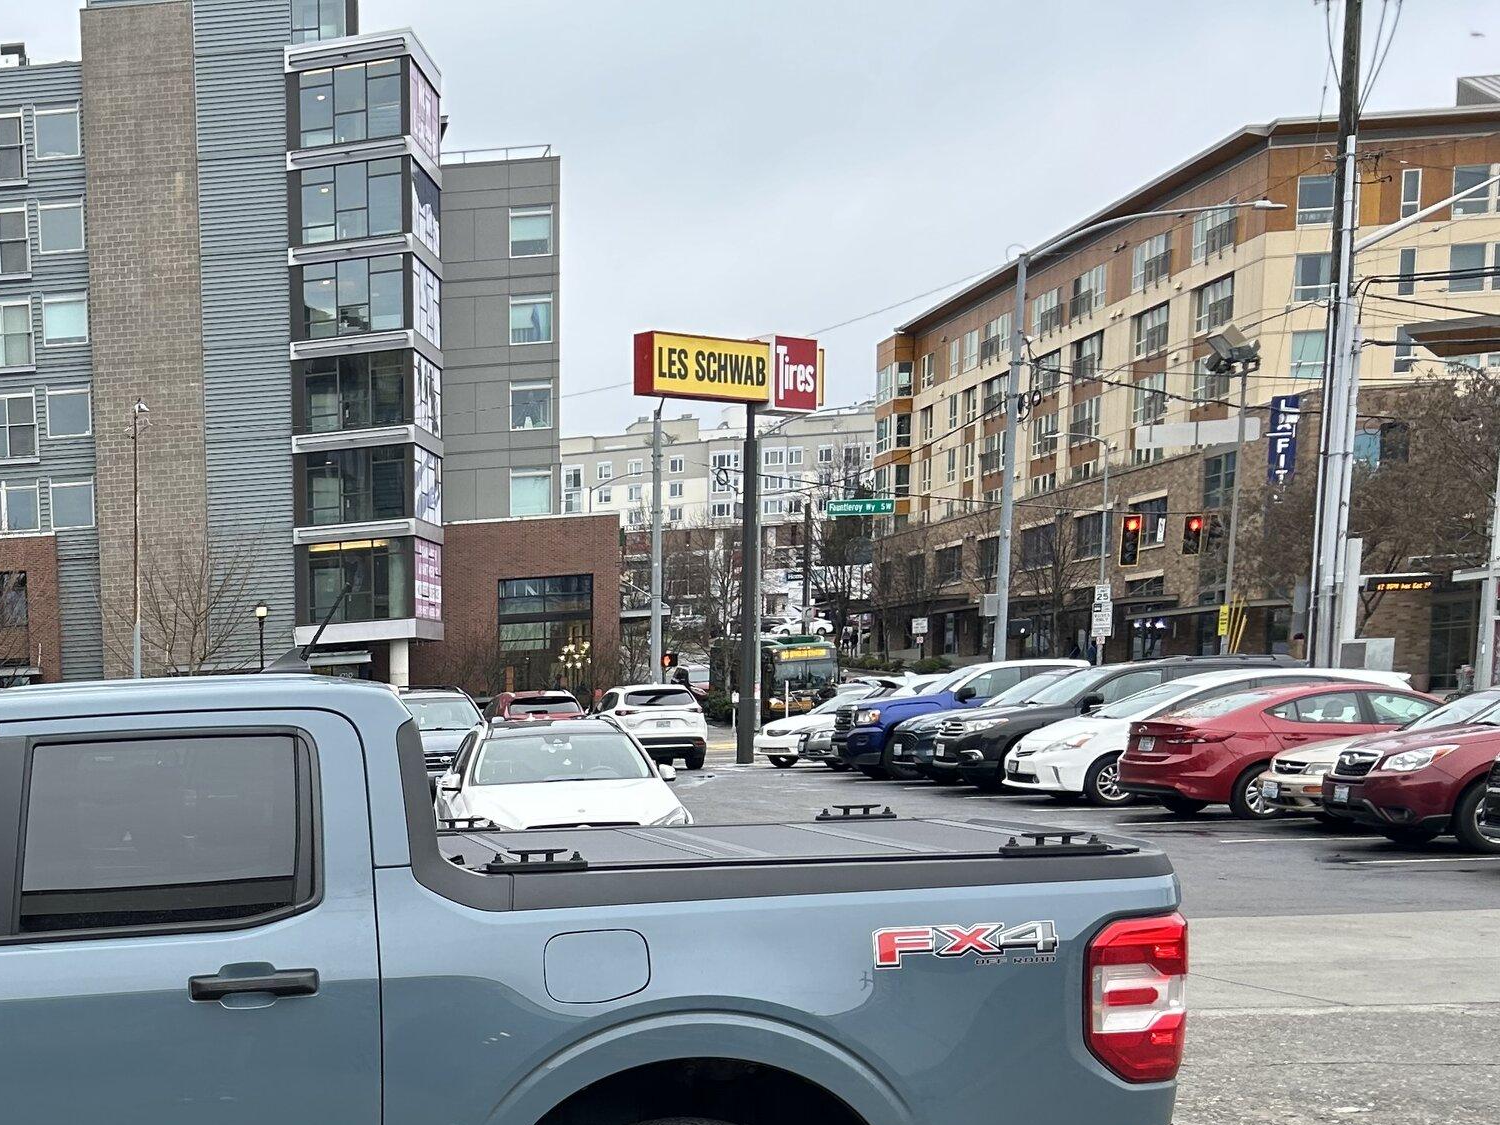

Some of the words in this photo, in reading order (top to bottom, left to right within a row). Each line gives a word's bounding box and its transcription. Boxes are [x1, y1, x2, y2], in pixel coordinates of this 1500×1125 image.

[657, 347, 689, 380] LES
[695, 350, 766, 387] SCHWAB
[776, 345, 815, 400] Tires
[828, 503, 863, 512] Fauntleroy
[866, 503, 876, 512] Wy
[881, 502, 892, 510] SW
[1096, 593, 1109, 601] 25
[871, 919, 1059, 970] FX4
[975, 957, 1008, 965] OFF
[1013, 956, 1056, 965] ROAD
